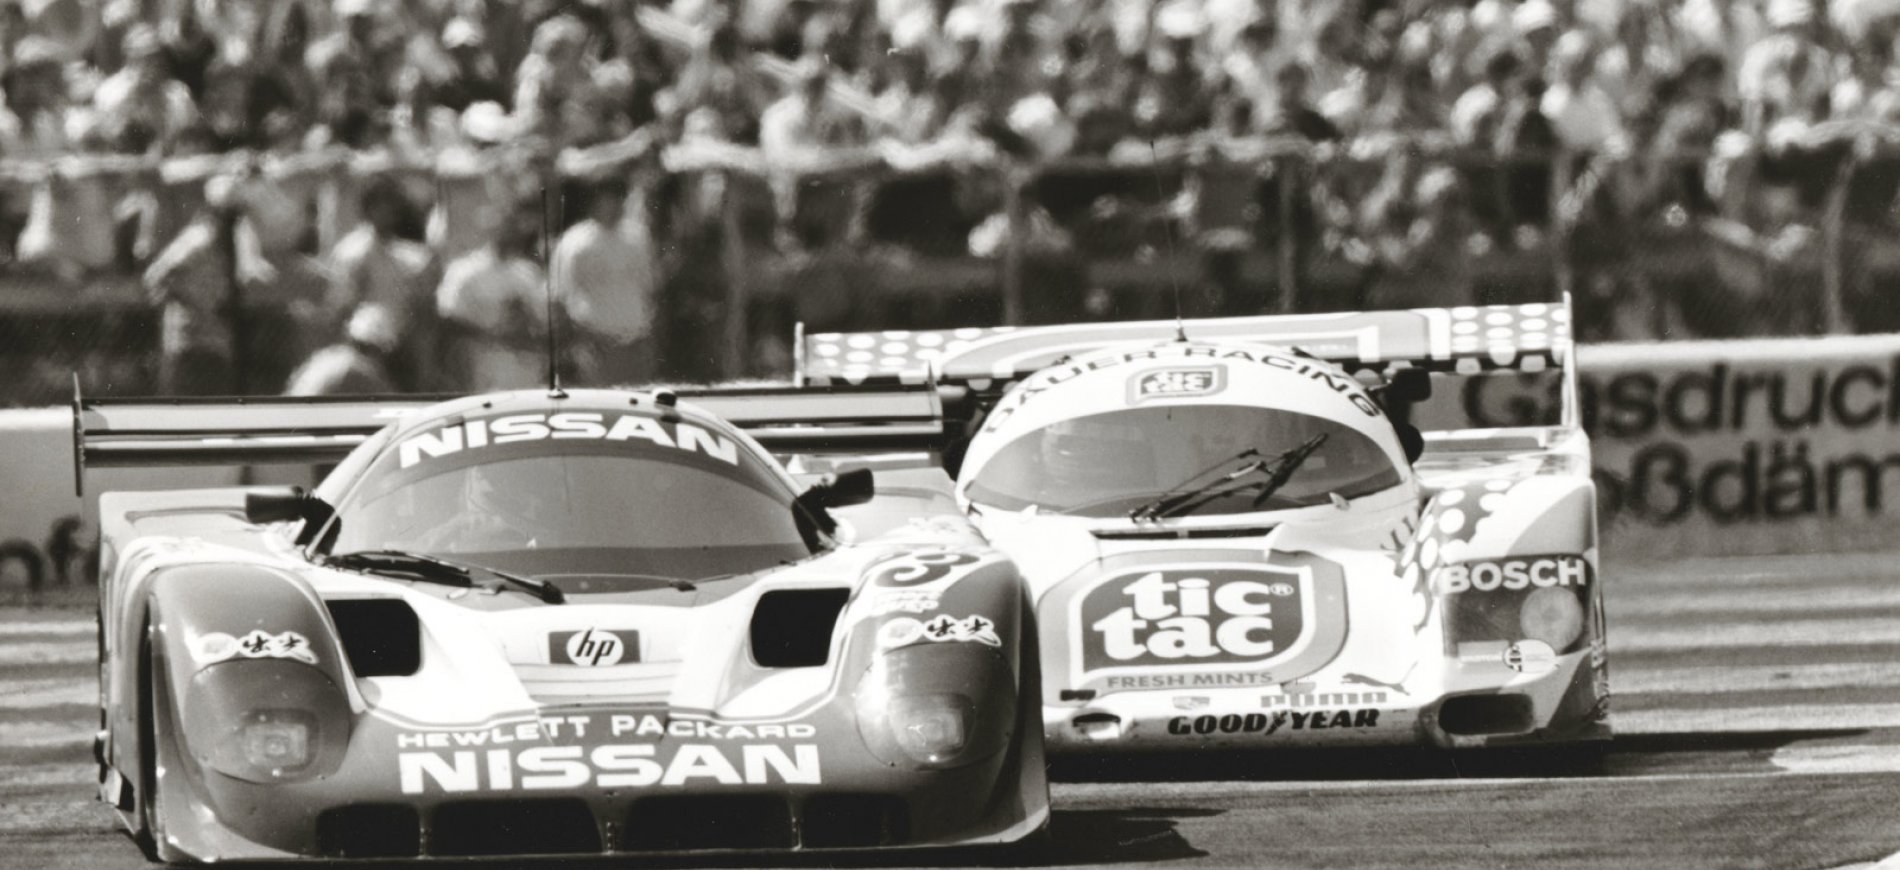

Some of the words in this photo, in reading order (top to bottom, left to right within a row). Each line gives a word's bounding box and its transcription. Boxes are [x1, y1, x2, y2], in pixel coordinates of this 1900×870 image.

[984, 349, 1156, 434] DAUER
[1184, 346, 1382, 418] RACING
[400, 412, 738, 469] NISSAN
[1443, 558, 1586, 594] BOSCH
[575, 626, 615, 666] hp
[1092, 608, 1274, 662] tac
[1107, 673, 1184, 689] FRESH
[1201, 671, 1273, 686] MINTS
[397, 715, 592, 748] HEWLETT
[612, 714, 816, 740] PACKARD
[400, 744, 822, 794] NISSAN
